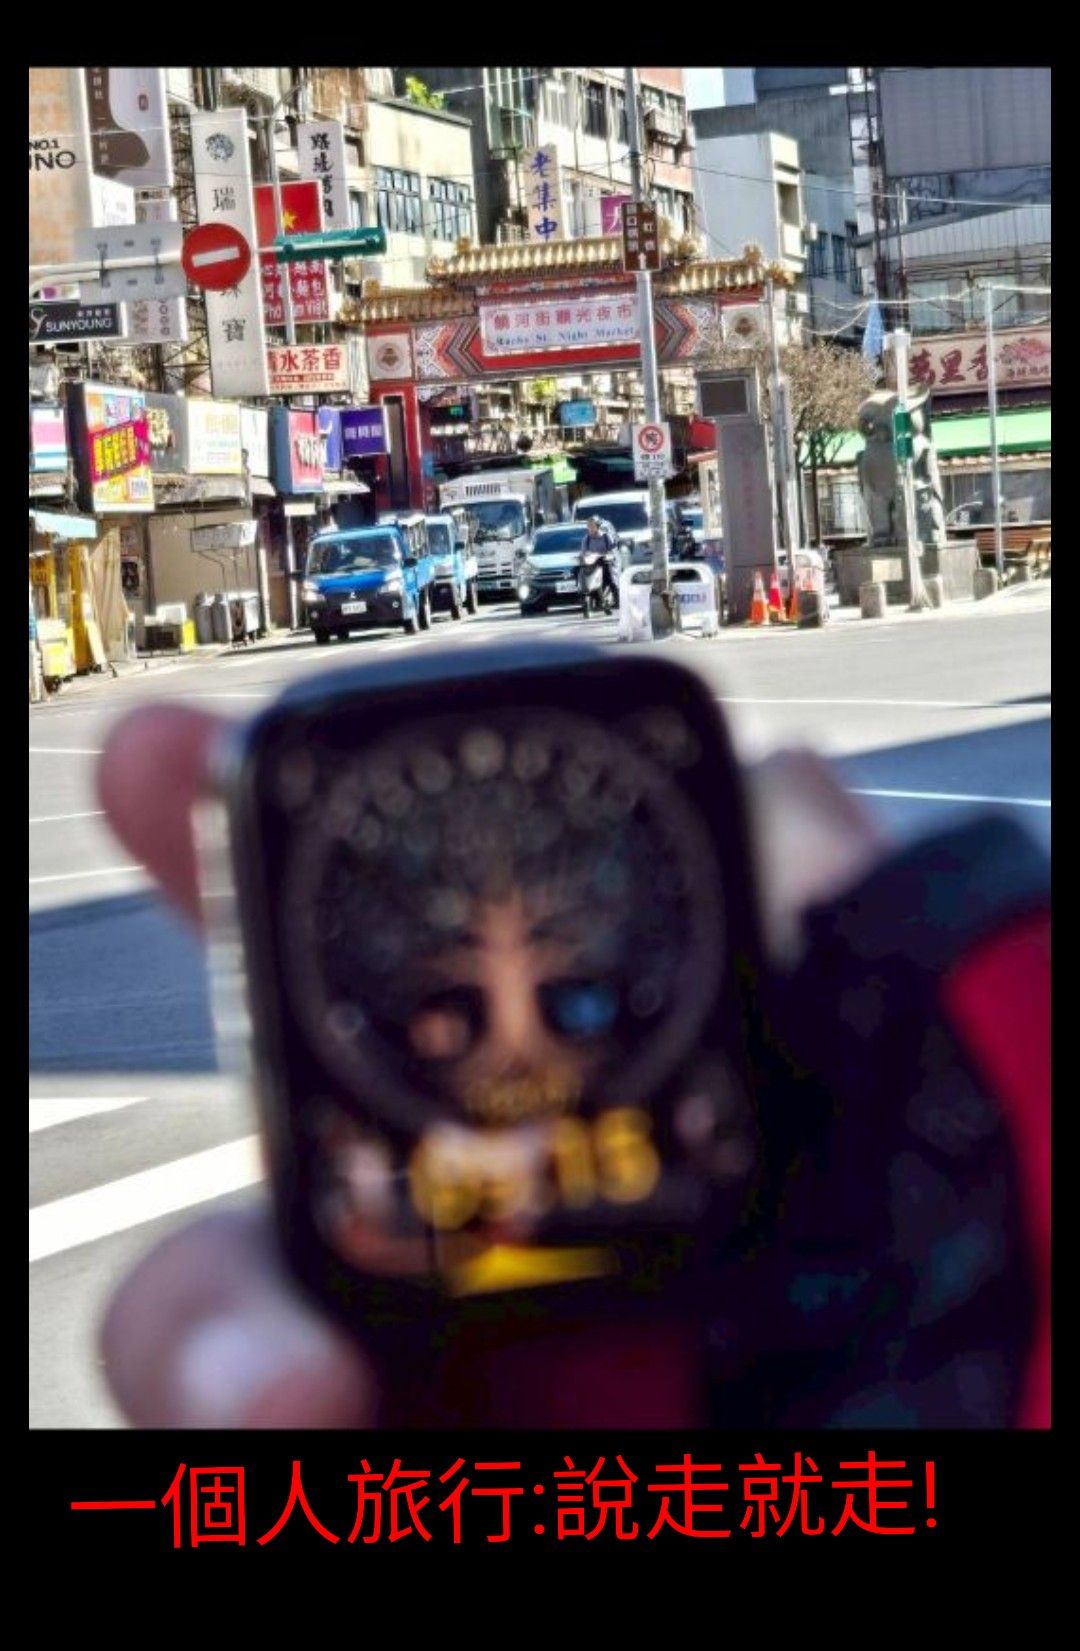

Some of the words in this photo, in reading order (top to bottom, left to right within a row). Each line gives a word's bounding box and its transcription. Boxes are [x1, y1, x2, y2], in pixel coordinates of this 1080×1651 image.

[530, 150, 558, 240] 老集中
[45, 317, 112, 332] SUNYOUNG
[493, 303, 632, 330] 饒河街觀光夜市
[595, 326, 634, 339] Market
